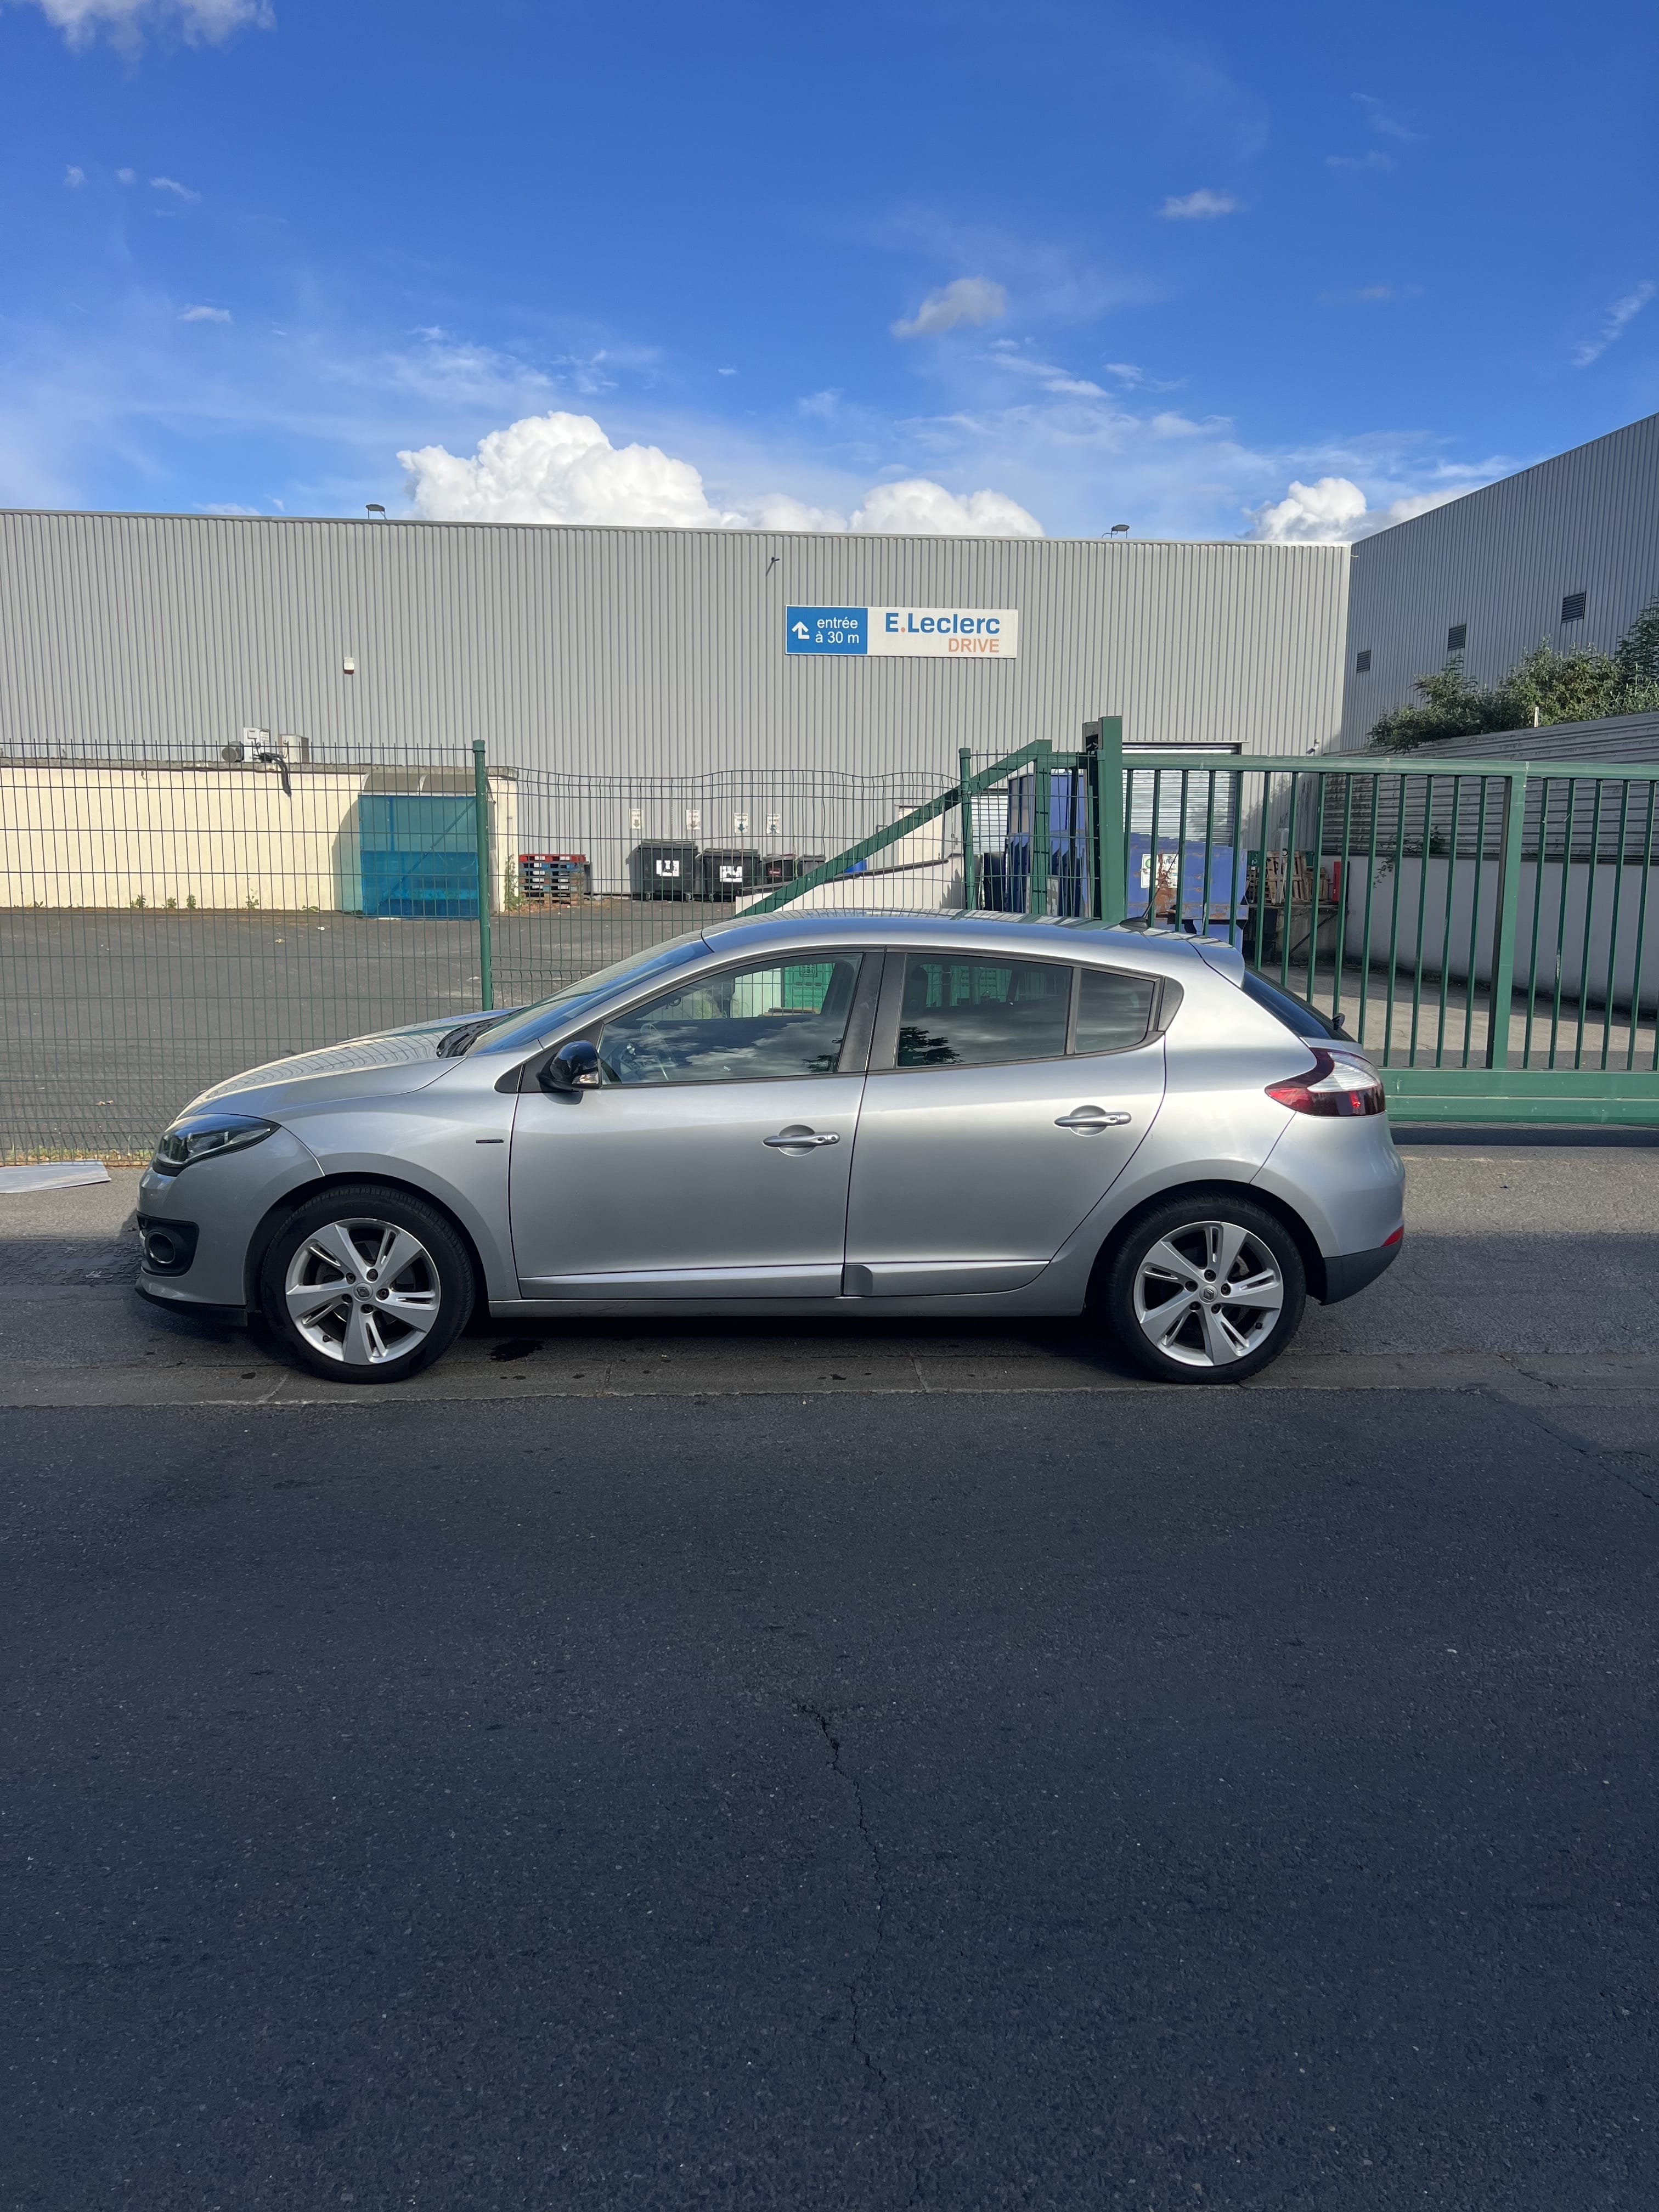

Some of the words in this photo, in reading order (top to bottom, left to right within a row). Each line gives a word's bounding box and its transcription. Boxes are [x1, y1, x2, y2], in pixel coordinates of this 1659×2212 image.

[817, 616, 858, 629] entrée
[885, 613, 1000, 634] E.Leclerc
[815, 631, 823, 643] à
[827, 631, 843, 644] 30
[848, 634, 859, 644] m
[948, 638, 1000, 653] DRIVE
